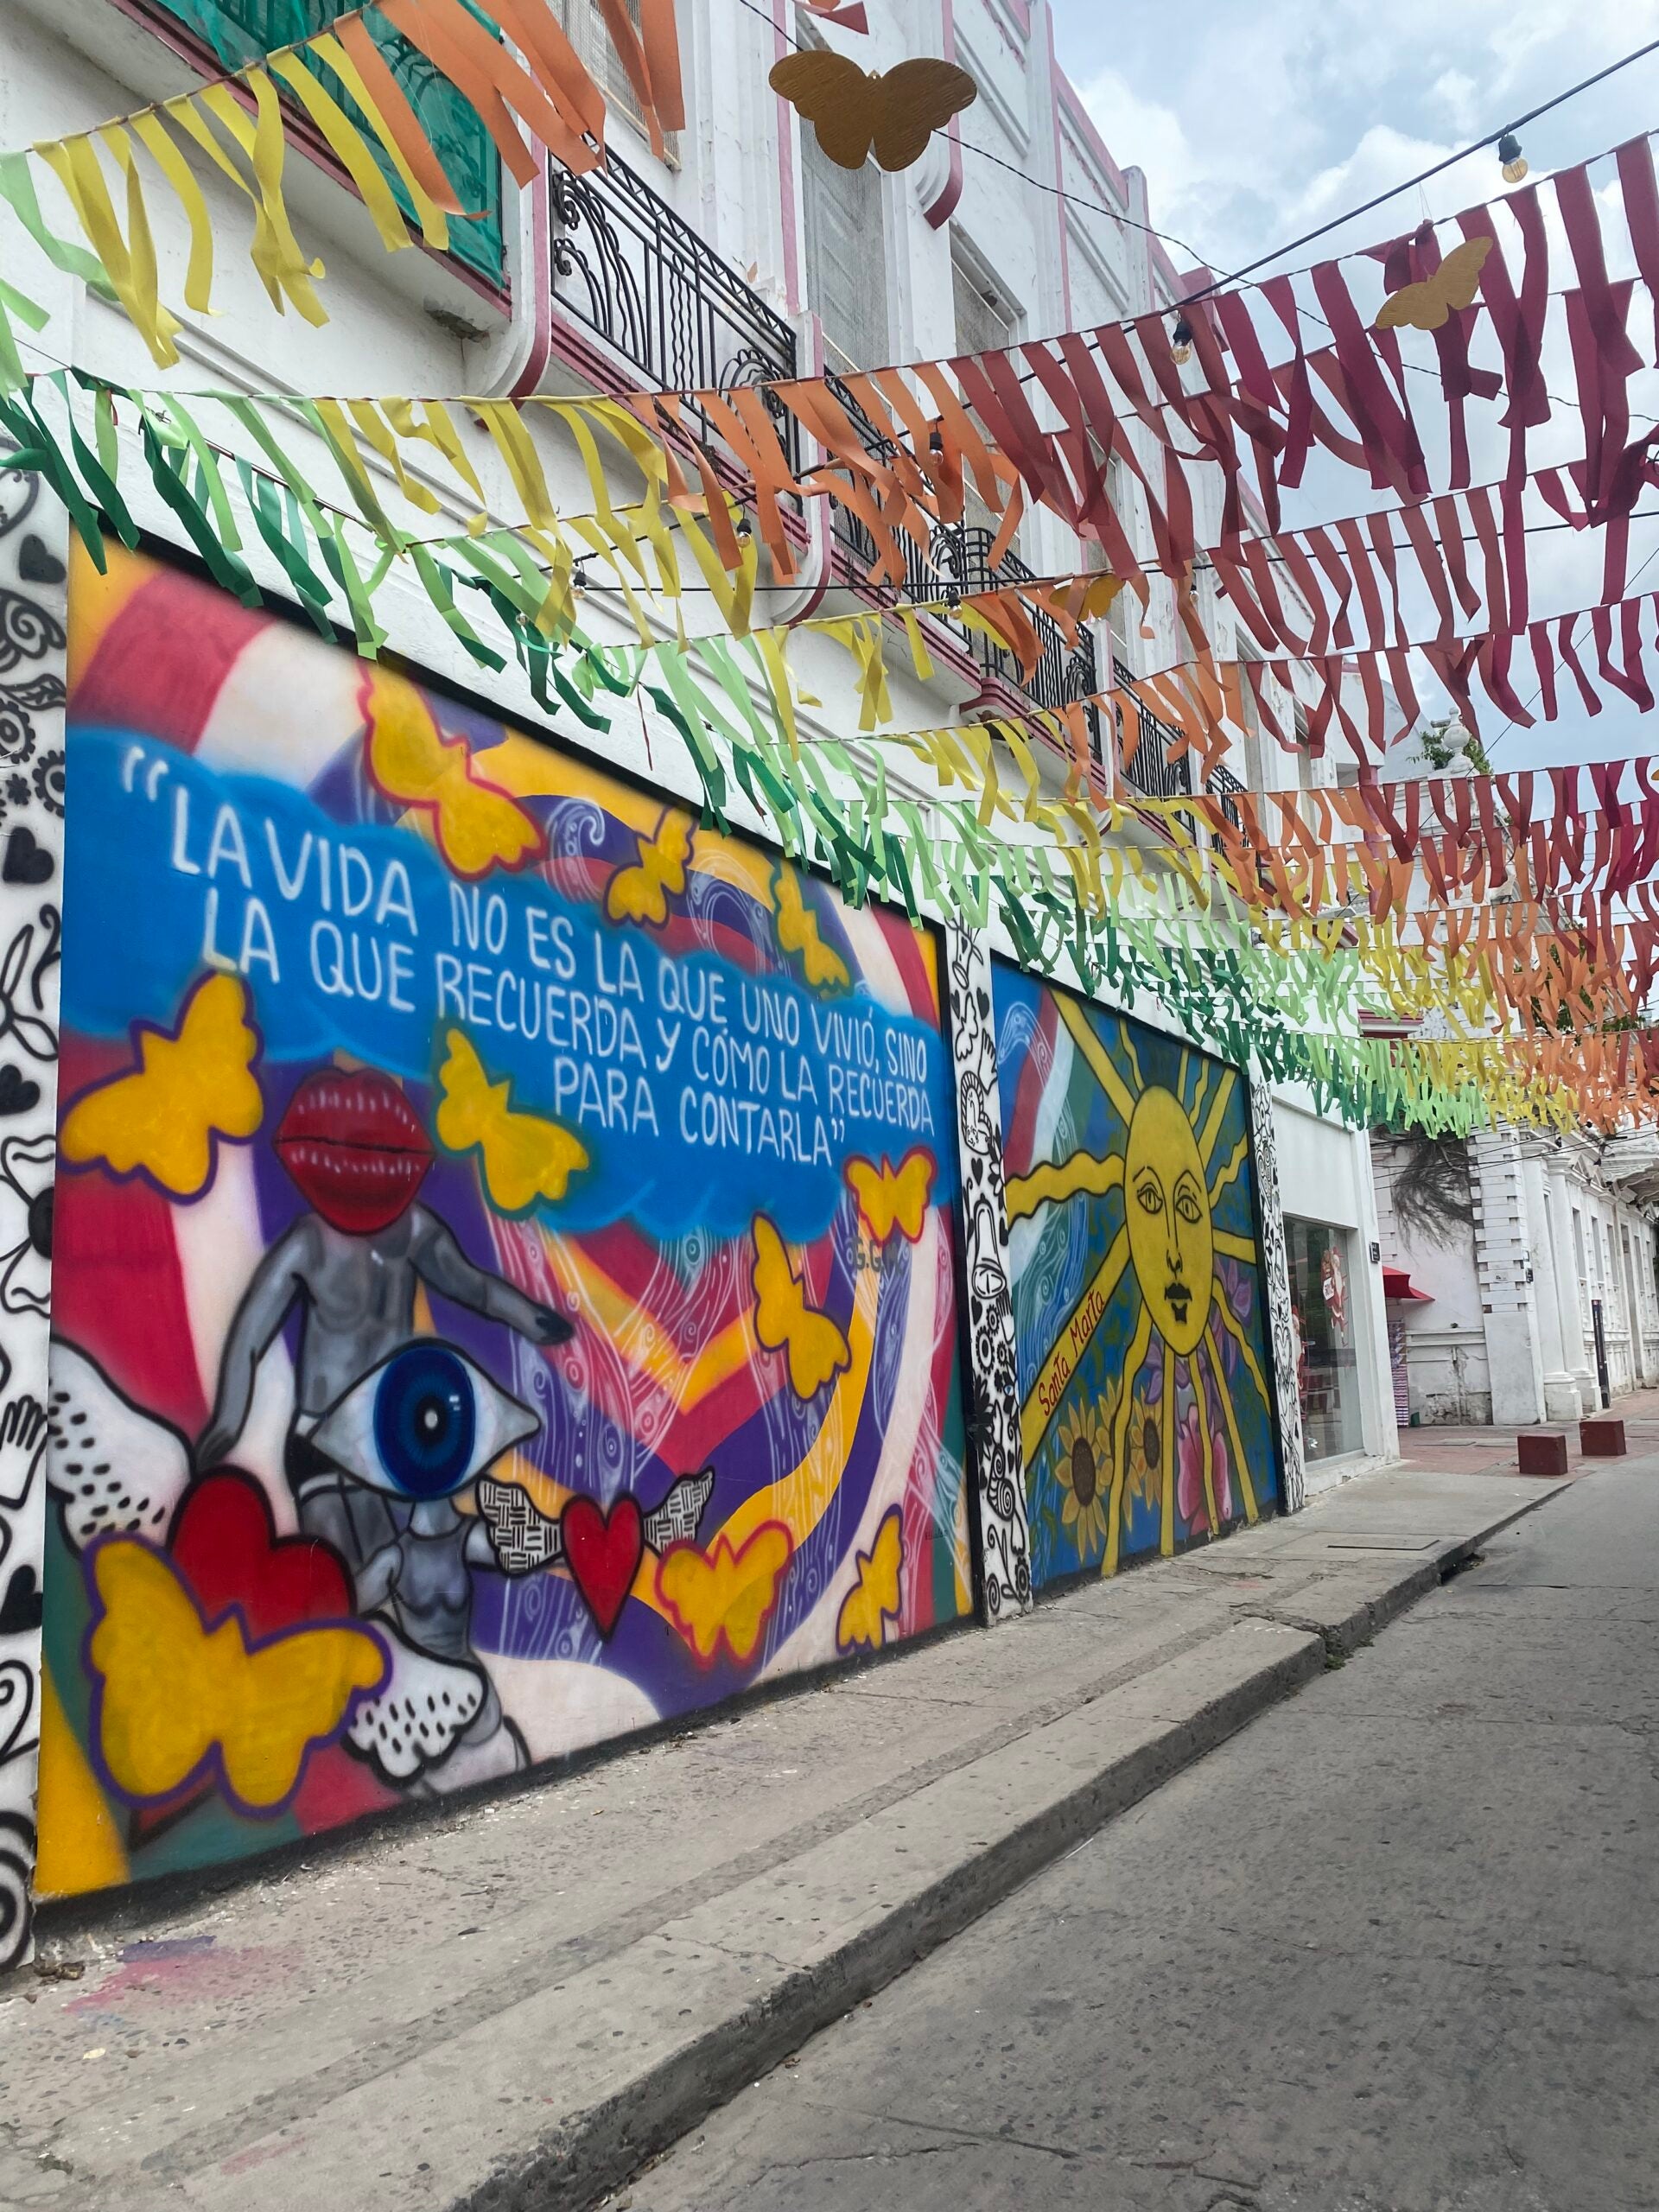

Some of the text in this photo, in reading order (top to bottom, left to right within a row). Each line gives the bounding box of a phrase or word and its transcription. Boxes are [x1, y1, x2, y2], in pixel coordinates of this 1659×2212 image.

[202, 887, 280, 983] LA
[310, 920, 416, 1013] QUE
[435, 953, 646, 1069] RECUERDA
[692, 1026, 770, 1095] CÓMO
[780, 1049, 818, 1106] LA
[829, 1064, 935, 1136] RECUERDA
[266, 819, 418, 936] VIDA
[449, 880, 508, 954] NO
[526, 907, 576, 979] ES
[595, 931, 644, 1001] LA
[658, 957, 728, 1024] QUE
[742, 982, 800, 1046] UNO
[811, 1005, 880, 1075] VIVIÓ,
[885, 1027, 927, 1084] SINO
[555, 1057, 846, 1166] PARA CONTARLA”
[1039, 1289, 1105, 1416] Santa Marta
